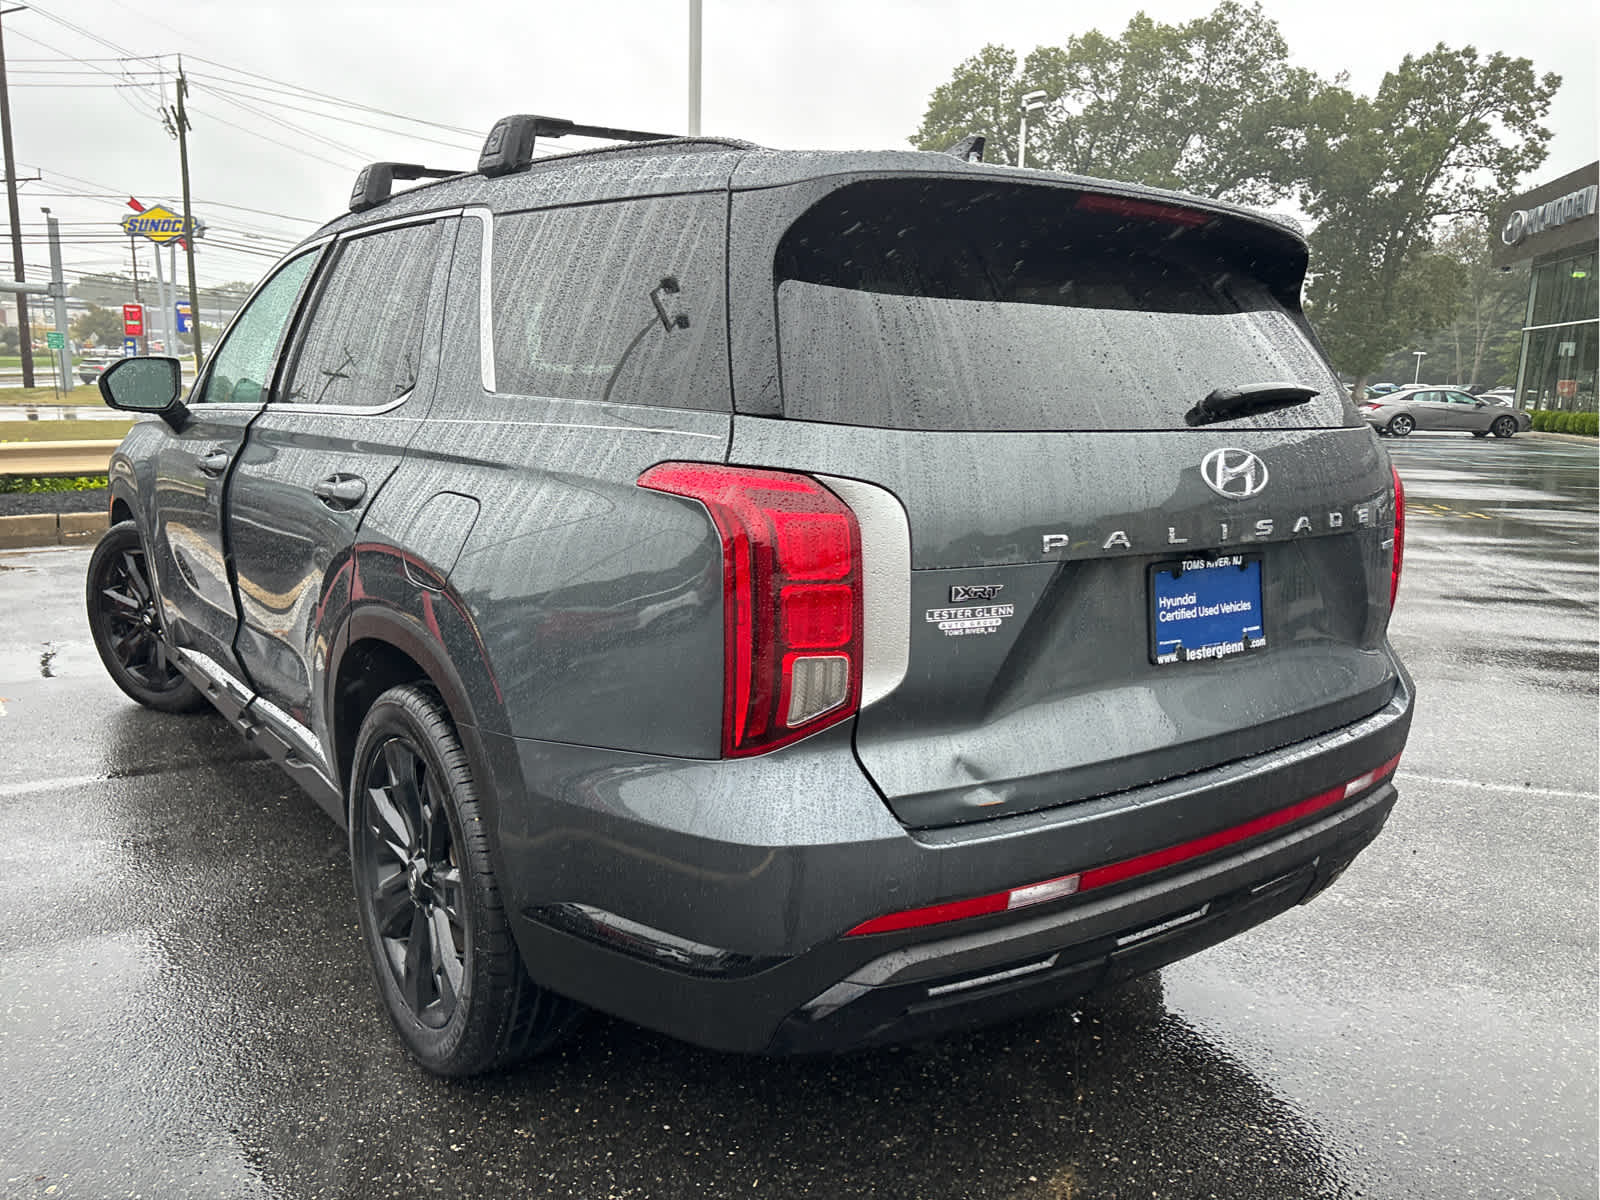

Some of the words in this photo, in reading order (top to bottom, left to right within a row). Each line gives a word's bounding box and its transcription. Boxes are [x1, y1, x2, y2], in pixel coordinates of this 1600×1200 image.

[127, 218, 190, 232] SUNOC
[1042, 507, 1371, 553] PALISADE
[1182, 559, 1205, 571] TOMS
[1232, 555, 1243, 566] NJ
[953, 585, 1004, 601] XRT
[1158, 592, 1197, 610] Hyundai
[925, 609, 972, 620] LESTER
[975, 606, 1014, 617] GLENN
[1159, 606, 1197, 623] Certified
[1198, 603, 1220, 617] Used
[1220, 599, 1252, 614] Vehicles
[1157, 654, 1178, 665] www.
[1186, 641, 1244, 659] lesterglenn
